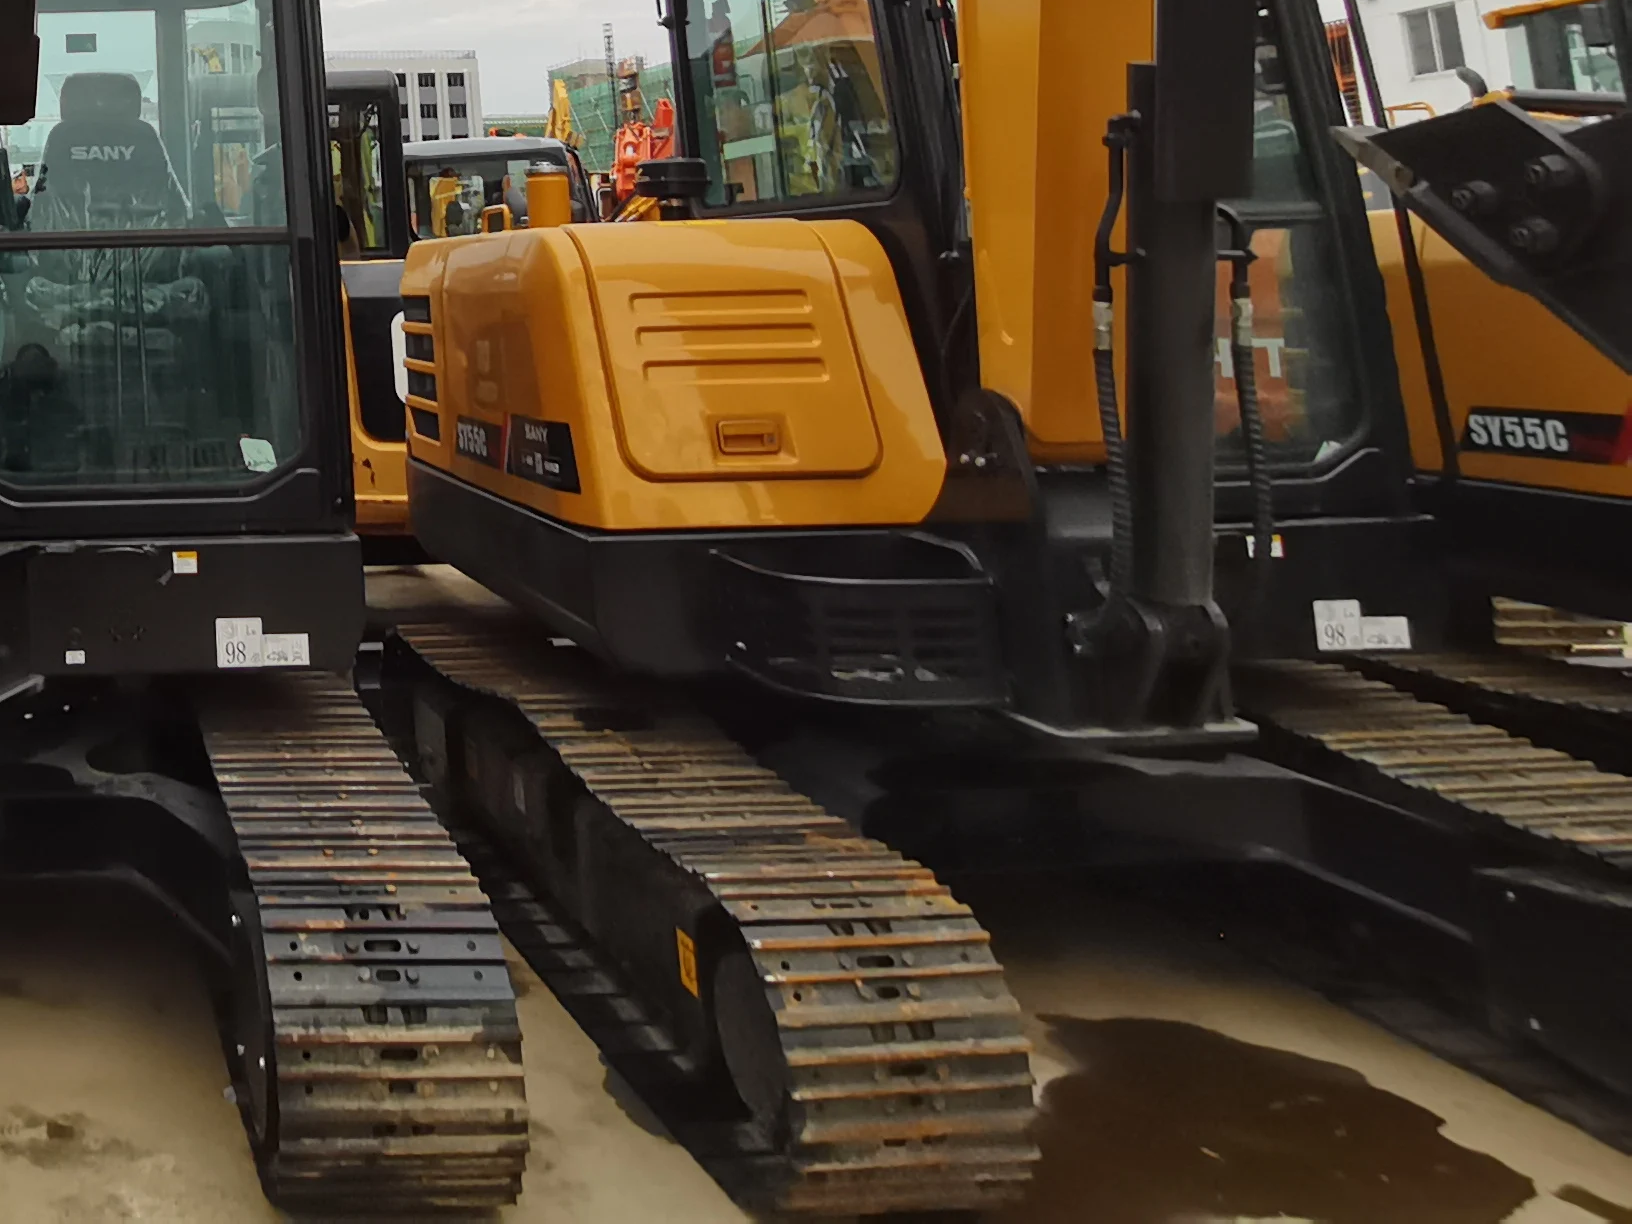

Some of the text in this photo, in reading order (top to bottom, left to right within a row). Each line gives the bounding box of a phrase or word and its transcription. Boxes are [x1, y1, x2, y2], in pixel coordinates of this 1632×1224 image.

[70, 145, 136, 162] SANY
[1468, 414, 1569, 452] SY55C
[1324, 623, 1347, 646] 98
[225, 641, 247, 664] 98
